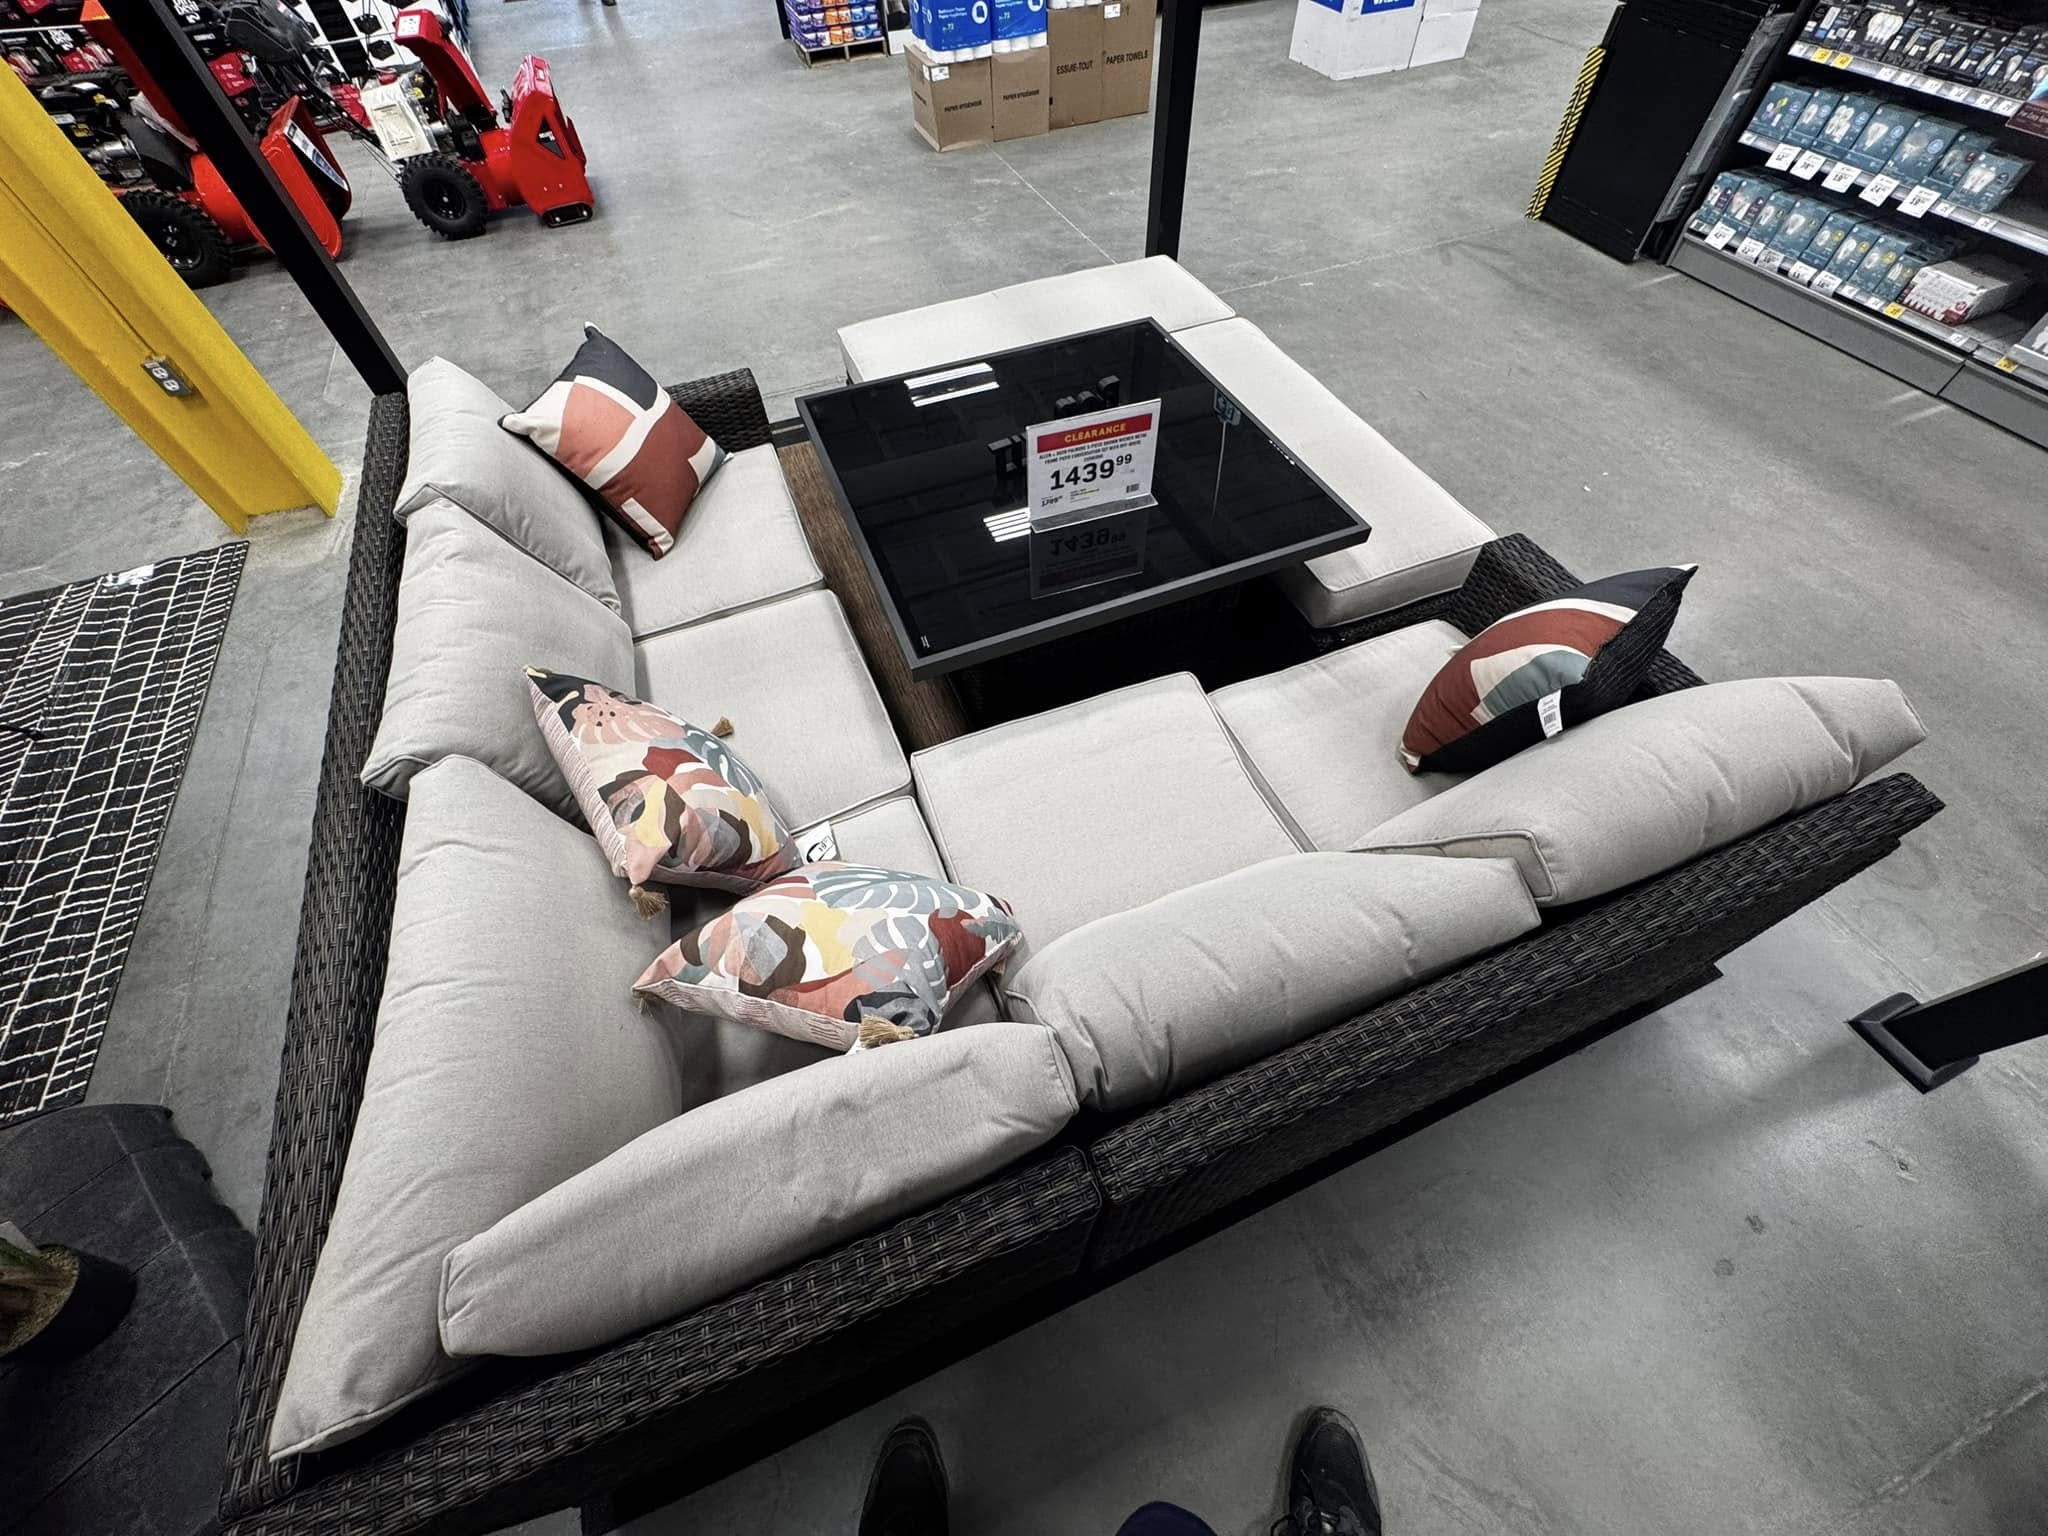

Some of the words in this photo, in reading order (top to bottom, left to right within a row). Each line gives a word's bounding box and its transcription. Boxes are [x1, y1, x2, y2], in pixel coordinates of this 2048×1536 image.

[1105, 54, 1125, 65] PAPER
[1126, 50, 1149, 61] TOWELS
[1056, 60, 1093, 75] ESSUIE-TOUT
[1064, 423, 1127, 443] CLEARANCE
[1050, 459, 1115, 491] 1439
[1116, 453, 1133, 466] 99
